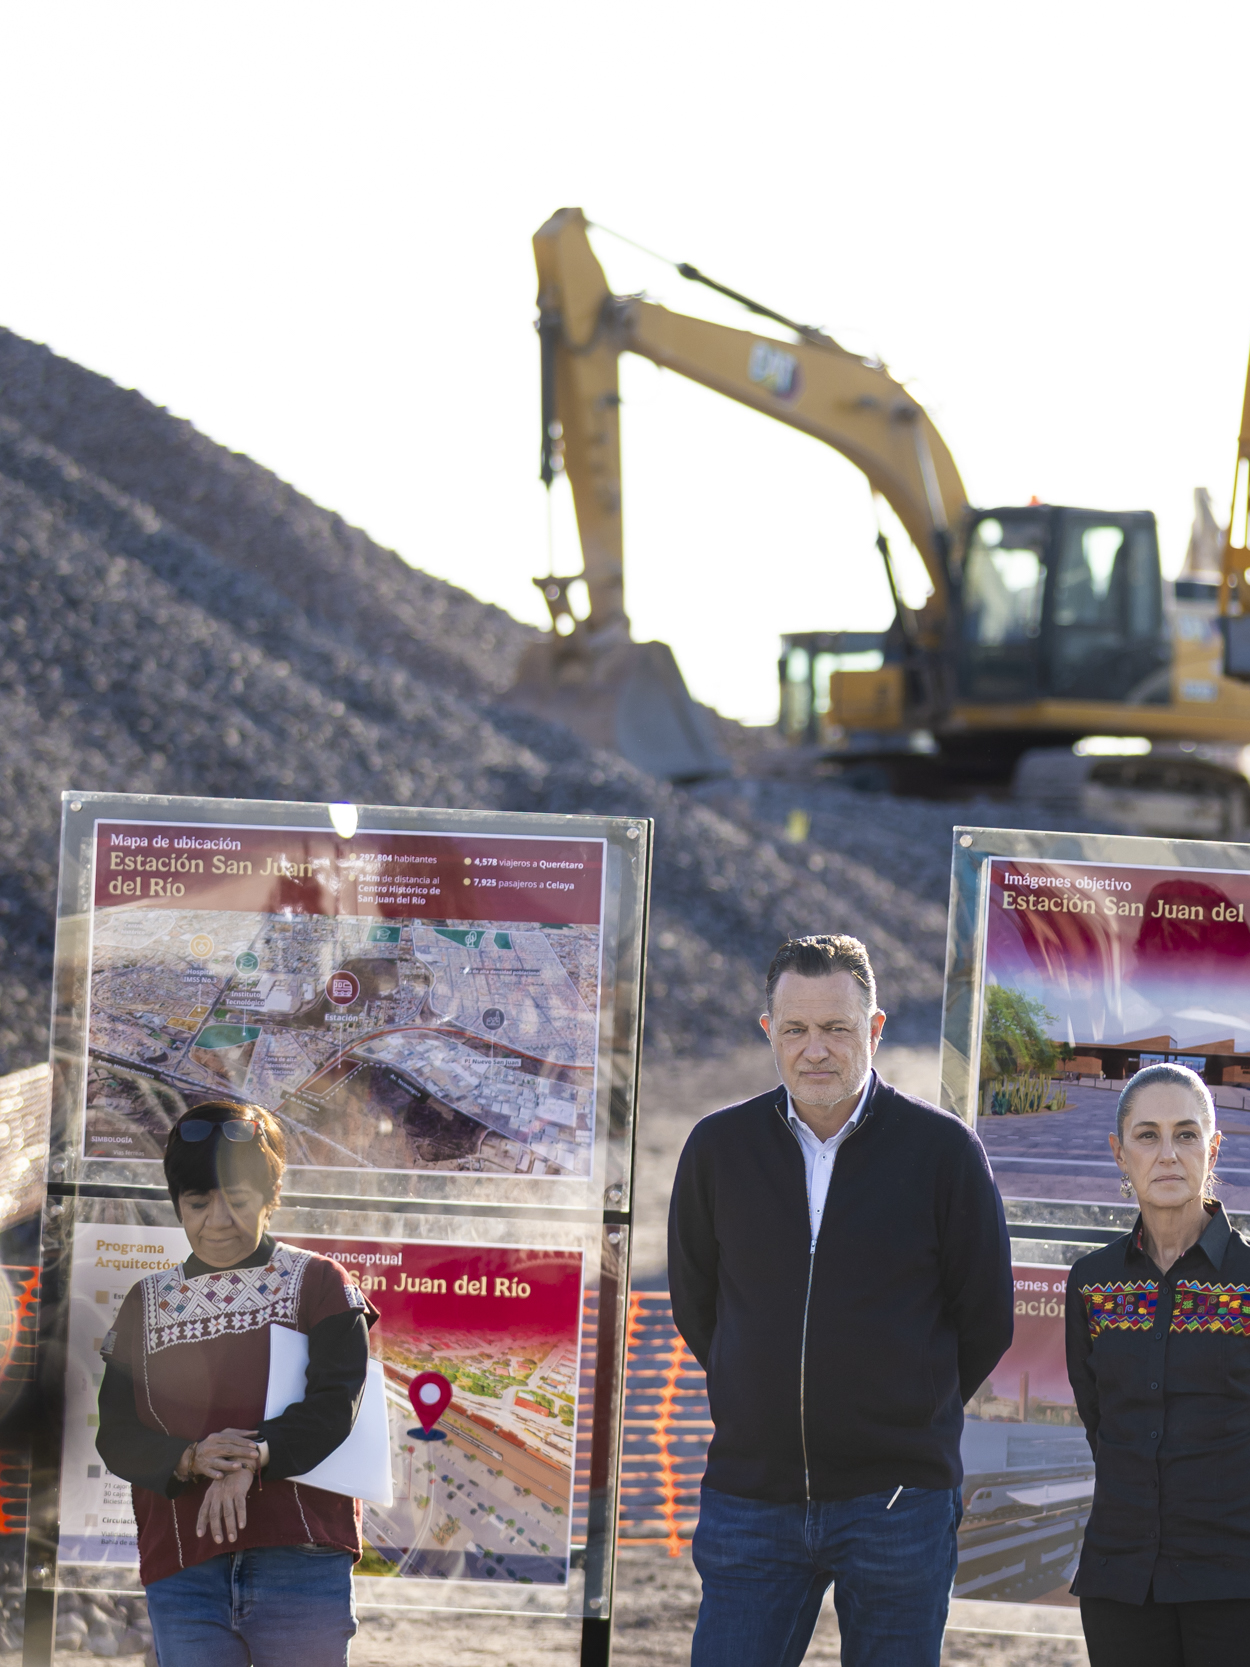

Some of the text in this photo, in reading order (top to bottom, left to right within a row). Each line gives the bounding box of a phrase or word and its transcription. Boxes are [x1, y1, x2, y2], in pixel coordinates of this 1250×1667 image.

[110, 834, 241, 850] Mapa de ubicación
[109, 852, 313, 877] Estación San Juan
[359, 853, 437, 864] 297,804 habitantes
[474, 857, 498, 867] 4,578
[499, 859, 530, 869] viajeros
[539, 860, 584, 870] Querétaro
[382, 875, 392, 883] de
[394, 875, 430, 884] distancia
[432, 876, 439, 884] al
[473, 878, 497, 888] 7,925
[498, 879, 537, 890] pasajeros
[546, 880, 574, 891] Celaya
[1004, 872, 1132, 892] Imágenes objetivo
[108, 876, 185, 897] del Río
[358, 885, 440, 895] Centro Histórico de
[358, 894, 426, 905] San Juan del Río
[1002, 890, 1096, 915] Estación
[1103, 896, 1144, 917] San
[1151, 899, 1204, 921] Juan
[1211, 902, 1244, 923] del
[187, 968, 215, 976] Hospital
[226, 999, 265, 1007] Tecnológico
[324, 1013, 358, 1022] Estación
[91, 1135, 133, 1144] SIMBOLOGÍA
[96, 1239, 165, 1255] Programa
[95, 1256, 185, 1271] Arquitectó
[325, 1250, 402, 1267] conceptual
[348, 1270, 531, 1299] San Juan del Río
